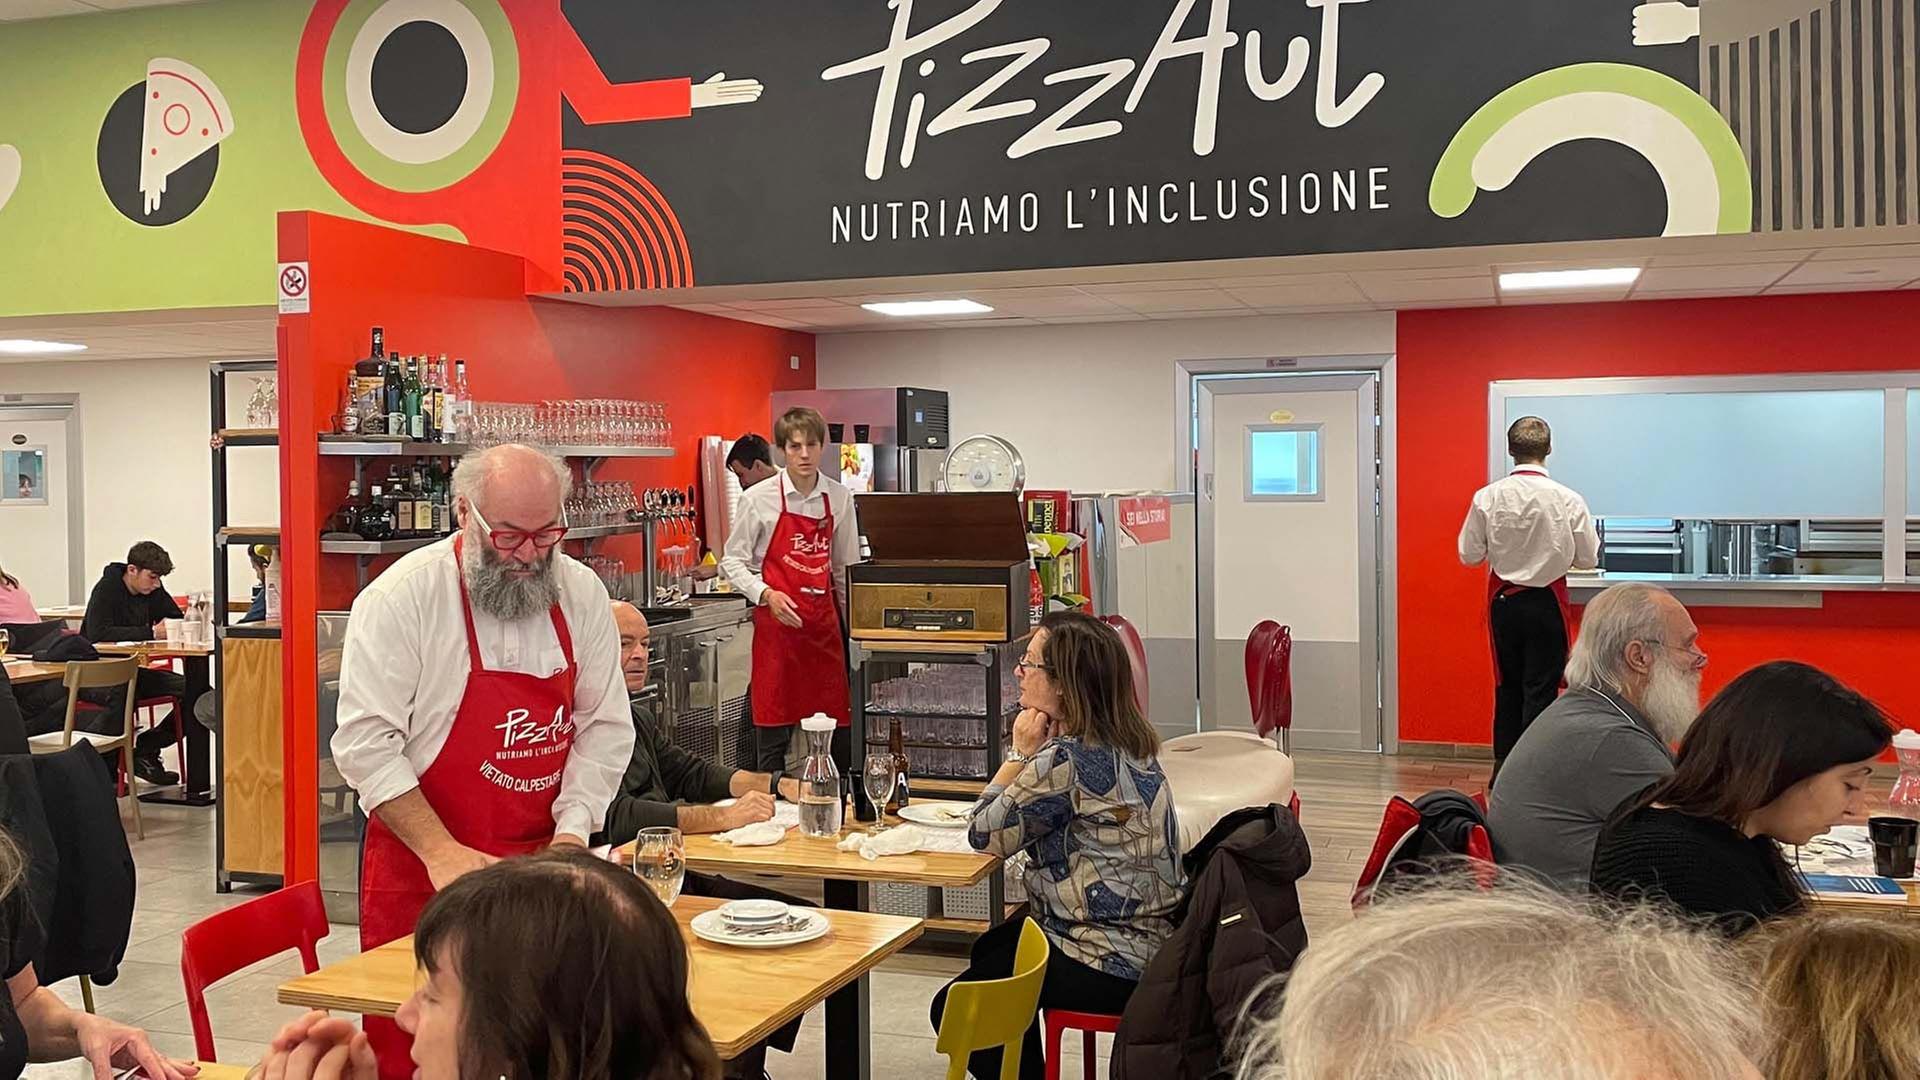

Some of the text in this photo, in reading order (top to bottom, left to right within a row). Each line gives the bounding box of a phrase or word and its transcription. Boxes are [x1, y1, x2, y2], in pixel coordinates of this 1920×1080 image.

[822, 0, 1385, 180] PizzAut
[831, 167, 1390, 243] NUTRIAMO L'INCLUSIONE
[479, 759, 515, 789] VIETATO
[496, 748, 533, 760] NUTRIAMO
